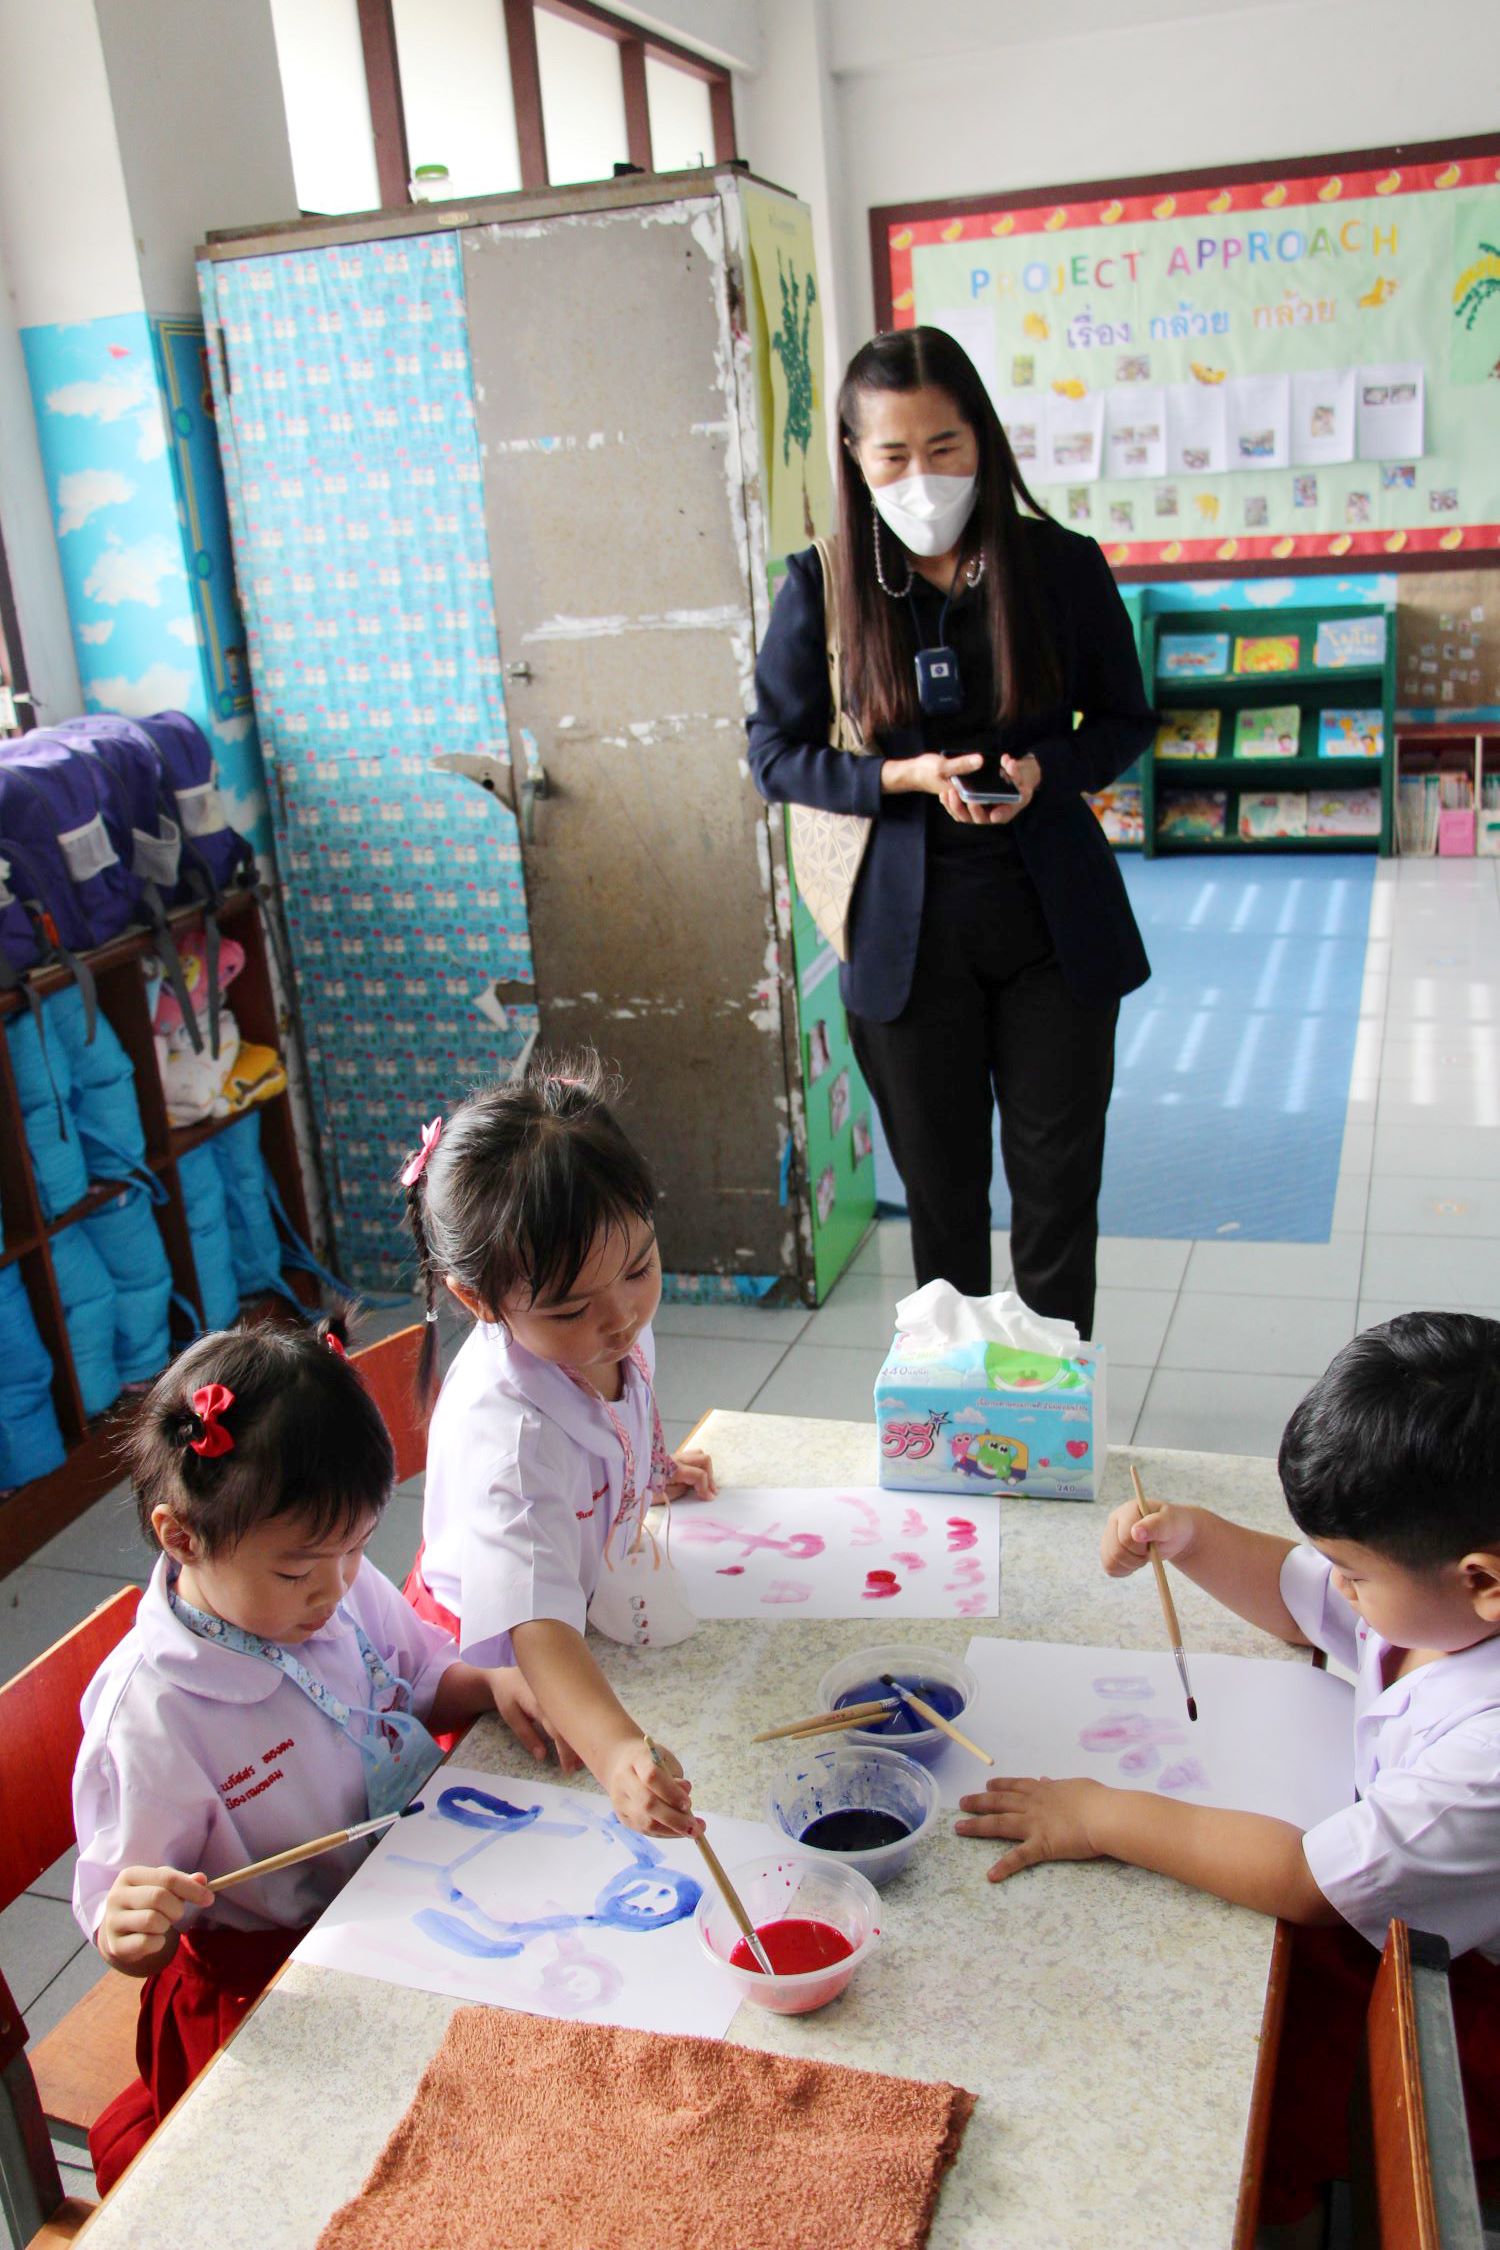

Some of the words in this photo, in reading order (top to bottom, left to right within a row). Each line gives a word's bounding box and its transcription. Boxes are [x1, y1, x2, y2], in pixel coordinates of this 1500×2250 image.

[970, 250, 1143, 299] PROJECT
[1166, 219, 1399, 277] APPROACH
[1066, 303, 1132, 349] เรื่อง
[1149, 301, 1230, 340] กล้วย
[1252, 288, 1338, 329] กล้วย
